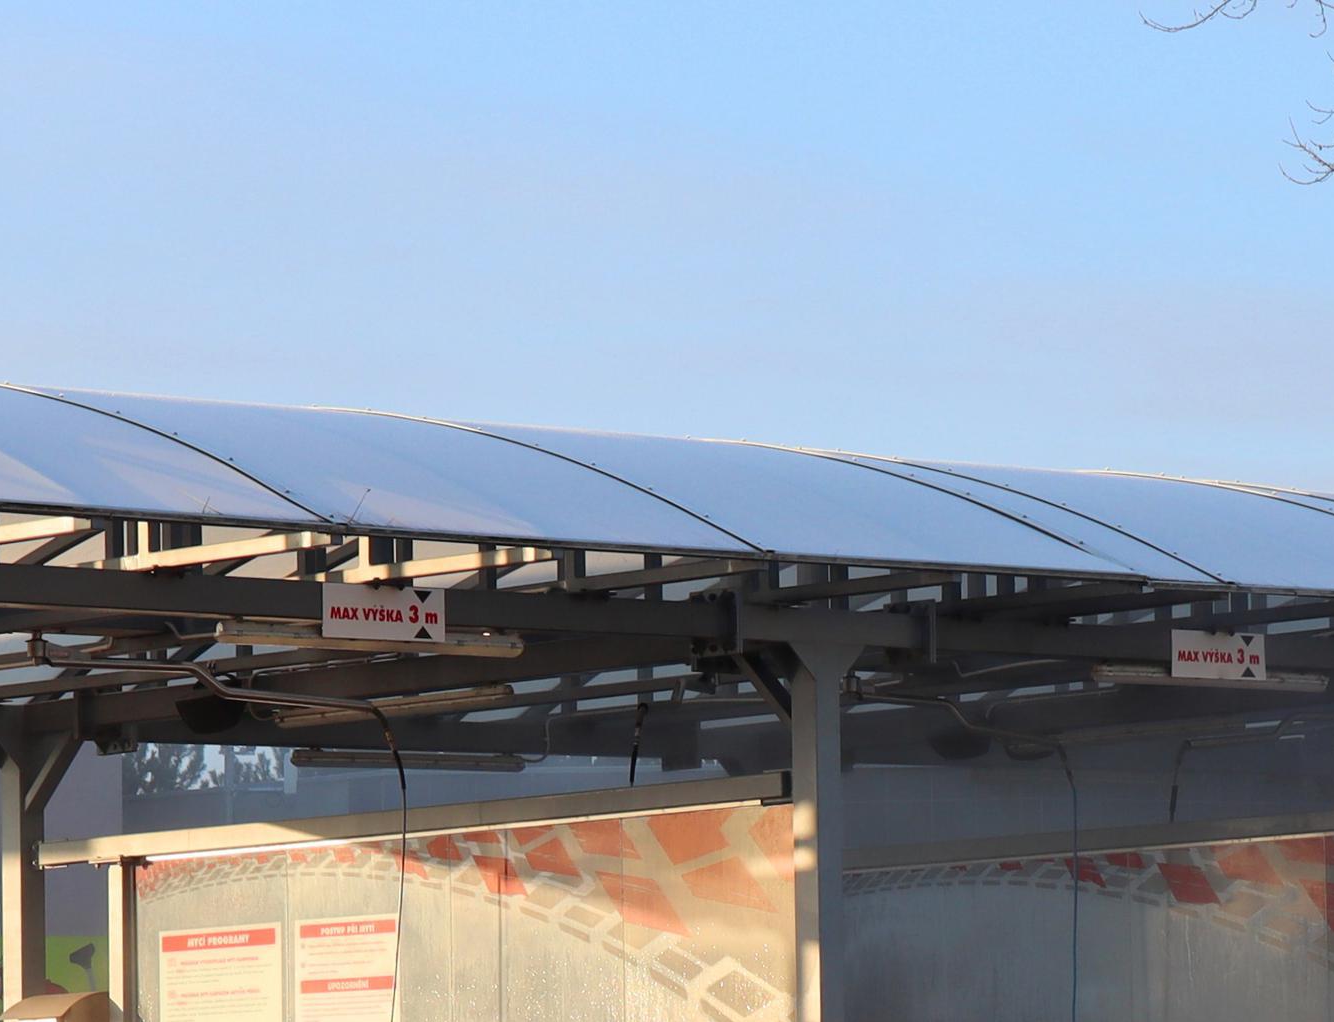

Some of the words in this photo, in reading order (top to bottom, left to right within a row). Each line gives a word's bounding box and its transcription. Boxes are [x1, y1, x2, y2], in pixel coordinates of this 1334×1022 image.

[330, 606, 359, 620] MAX
[362, 604, 403, 623] VÝŠKA
[409, 605, 419, 624] 3
[425, 612, 438, 625] m
[1178, 650, 1200, 662] MAX
[1202, 648, 1233, 664] VÝŠKA
[1237, 648, 1244, 664] 3
[1250, 655, 1260, 665] m
